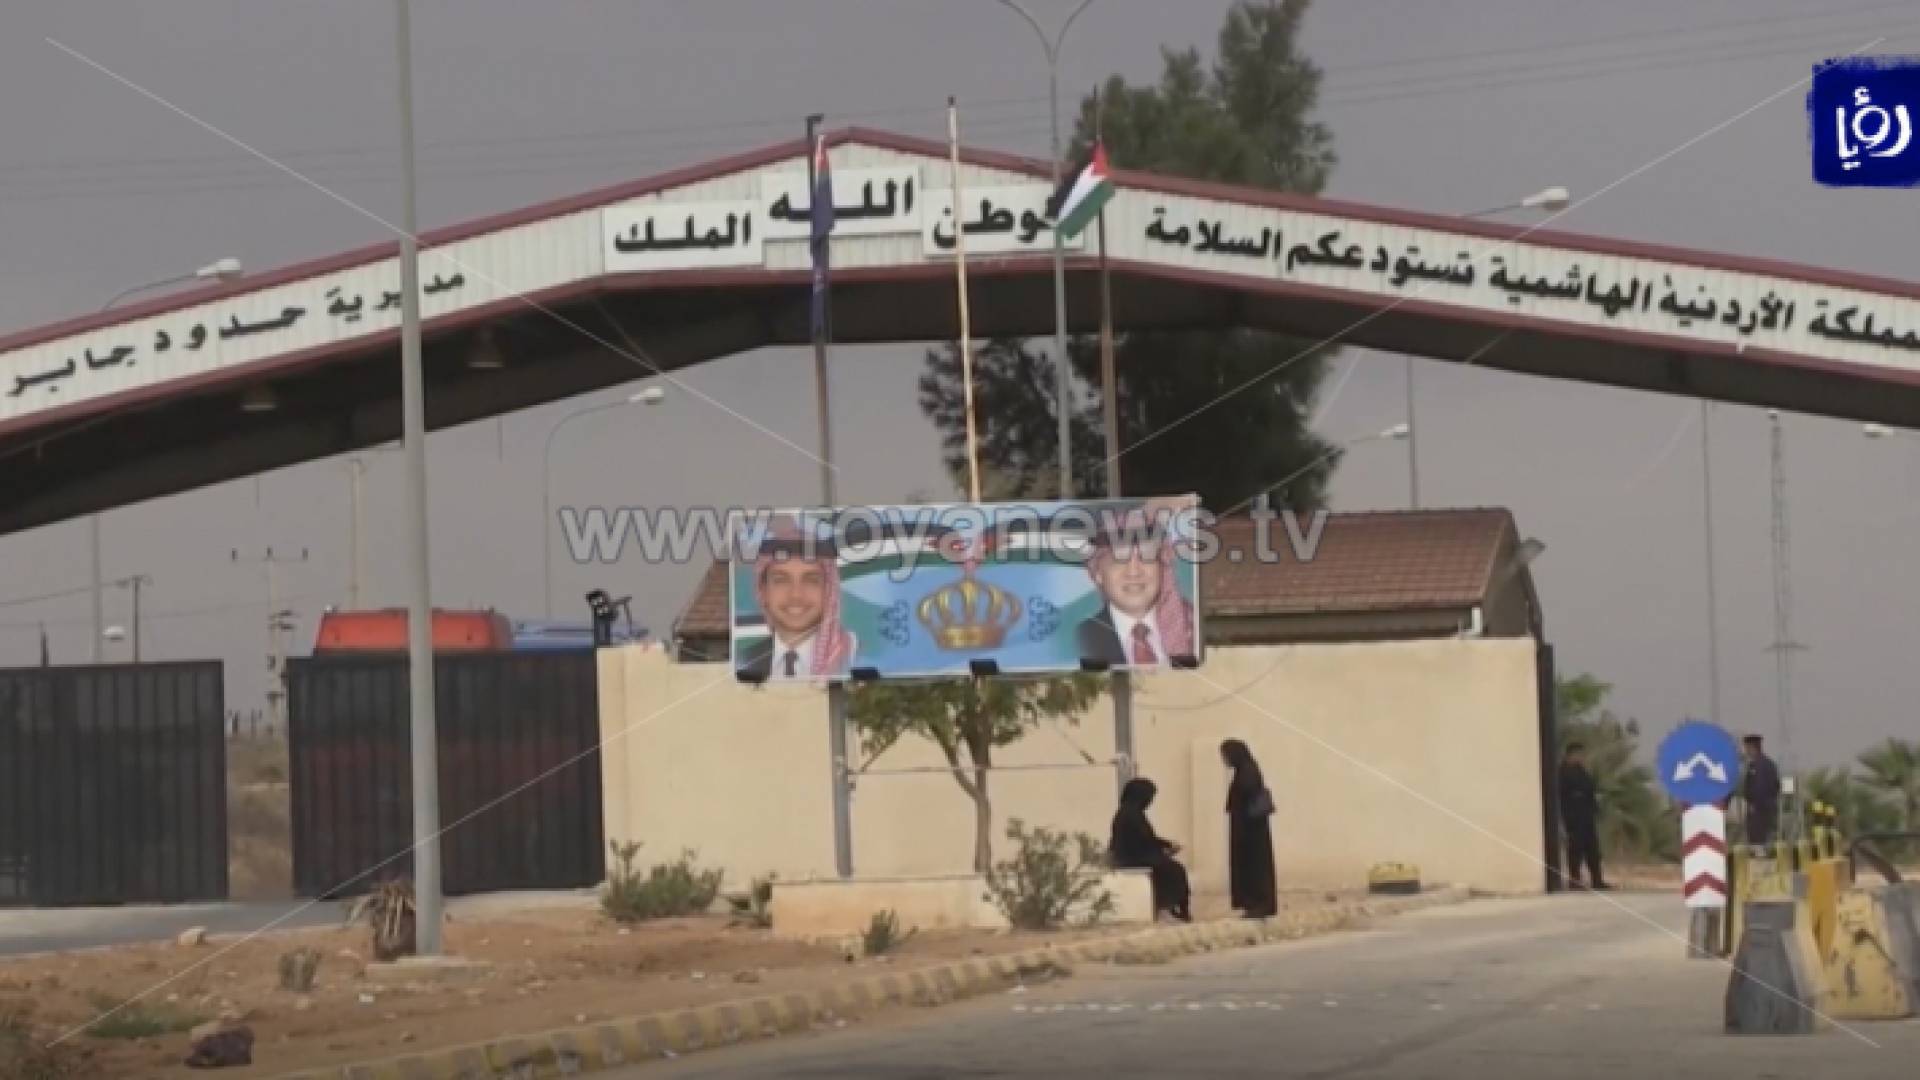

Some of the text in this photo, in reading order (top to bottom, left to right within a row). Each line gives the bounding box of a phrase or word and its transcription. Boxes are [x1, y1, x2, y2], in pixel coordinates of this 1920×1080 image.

[614, 212, 752, 253] الملك
[768, 176, 914, 222] الله
[1144, 207, 1920, 351] مملكة الأردنية الهاشمية تستودعكم السلامة
[7, 271, 465, 397] مديرية حدود جابر
